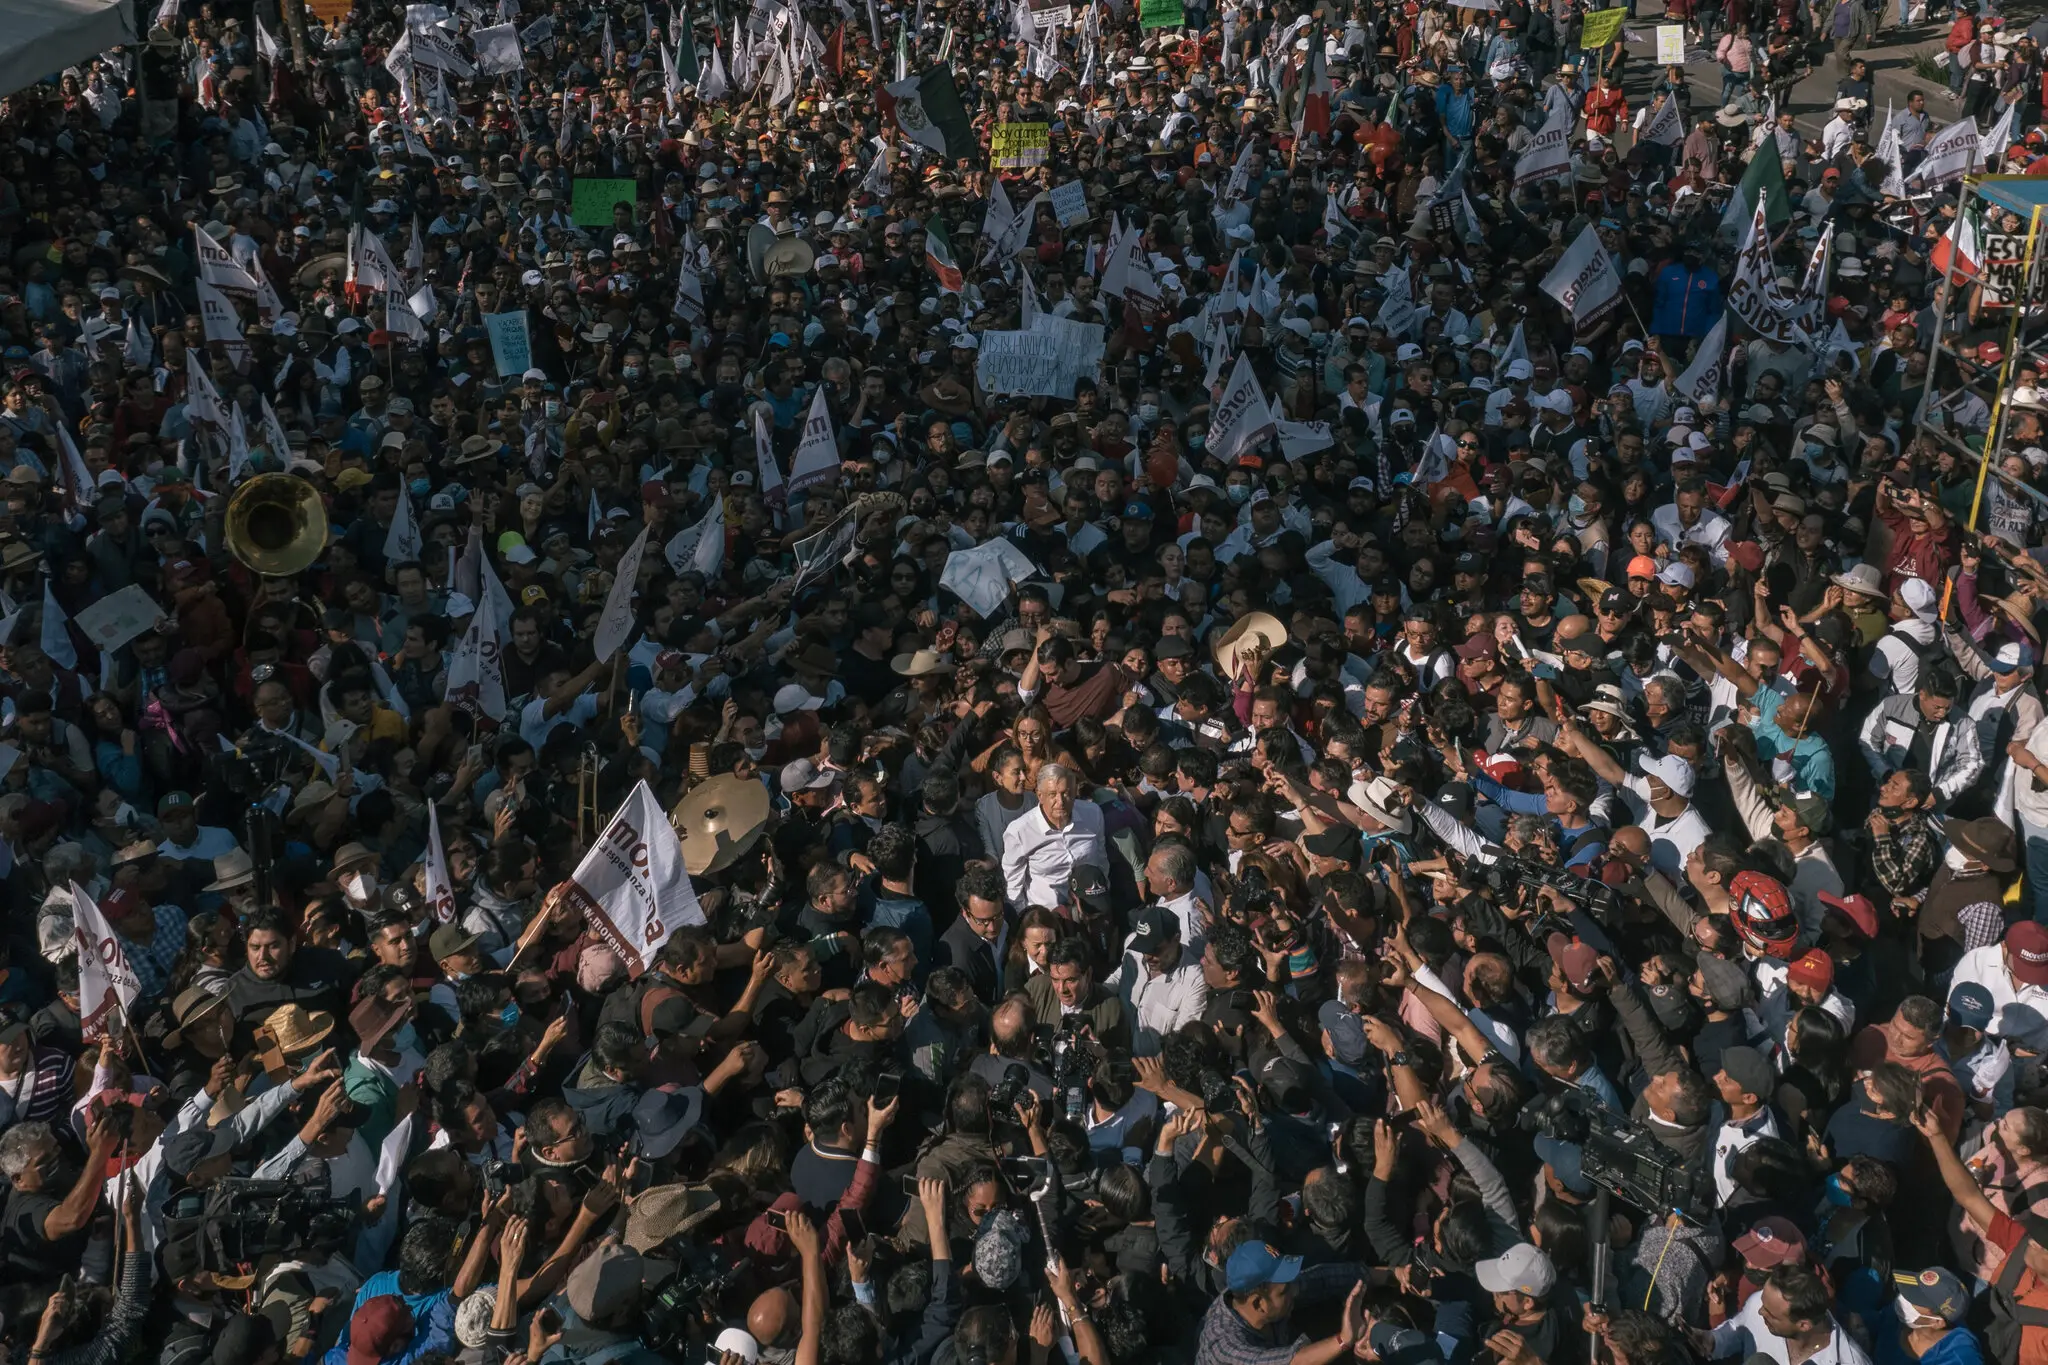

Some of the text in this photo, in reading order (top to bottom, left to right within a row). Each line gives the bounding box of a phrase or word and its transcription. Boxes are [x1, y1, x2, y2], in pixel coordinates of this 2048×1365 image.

[994, 125, 1012, 139] Soy
[597, 839, 607, 854] La
[605, 850, 646, 897] esperanza
[568, 891, 637, 968] www.morena.si
[1804, 960, 1816, 970] PT
